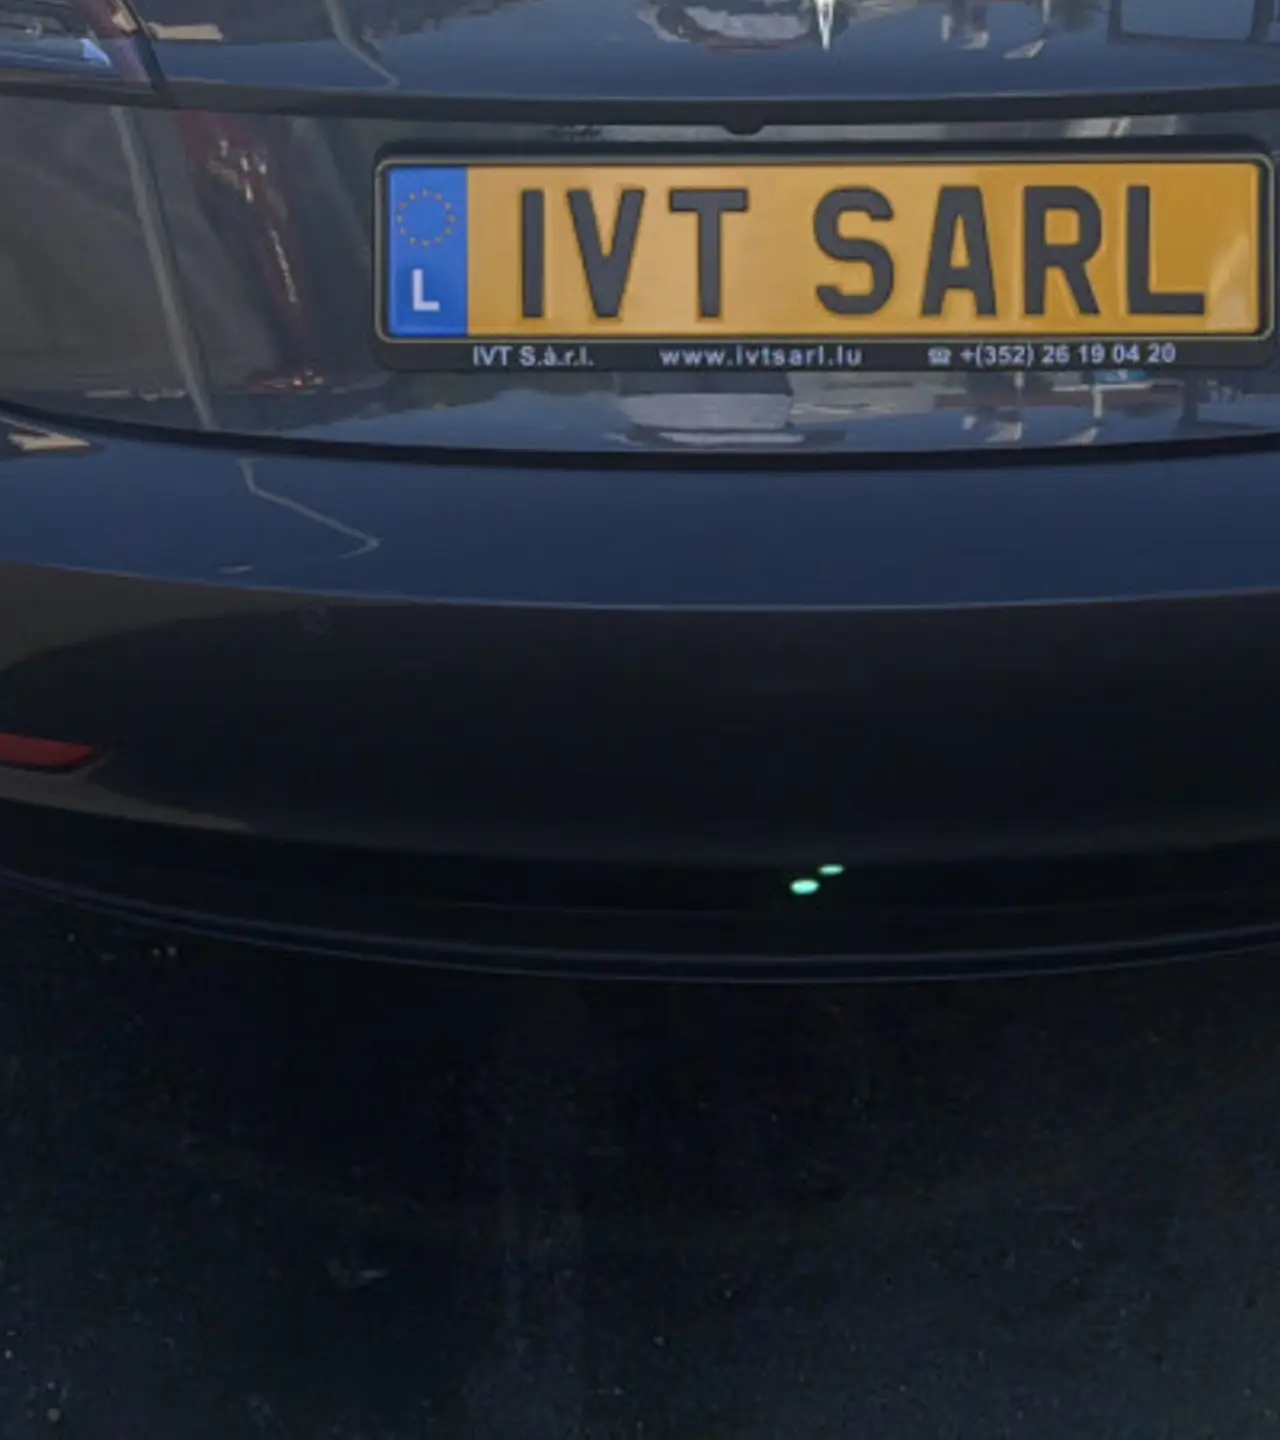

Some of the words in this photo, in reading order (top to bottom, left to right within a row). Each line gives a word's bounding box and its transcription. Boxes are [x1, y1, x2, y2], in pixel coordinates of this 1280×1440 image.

[519, 187, 750, 320] IVT
[811, 184, 1207, 318] SARL
[410, 269, 440, 312] L
[472, 345, 513, 367] IVT
[659, 344, 862, 367] www.ivtsarl.lu
[960, 342, 1033, 367] +(352)
[1041, 343, 1070, 364] 26
[1079, 343, 1105, 364] 19
[1112, 343, 1141, 363] 04
[1148, 342, 1176, 363] 20
